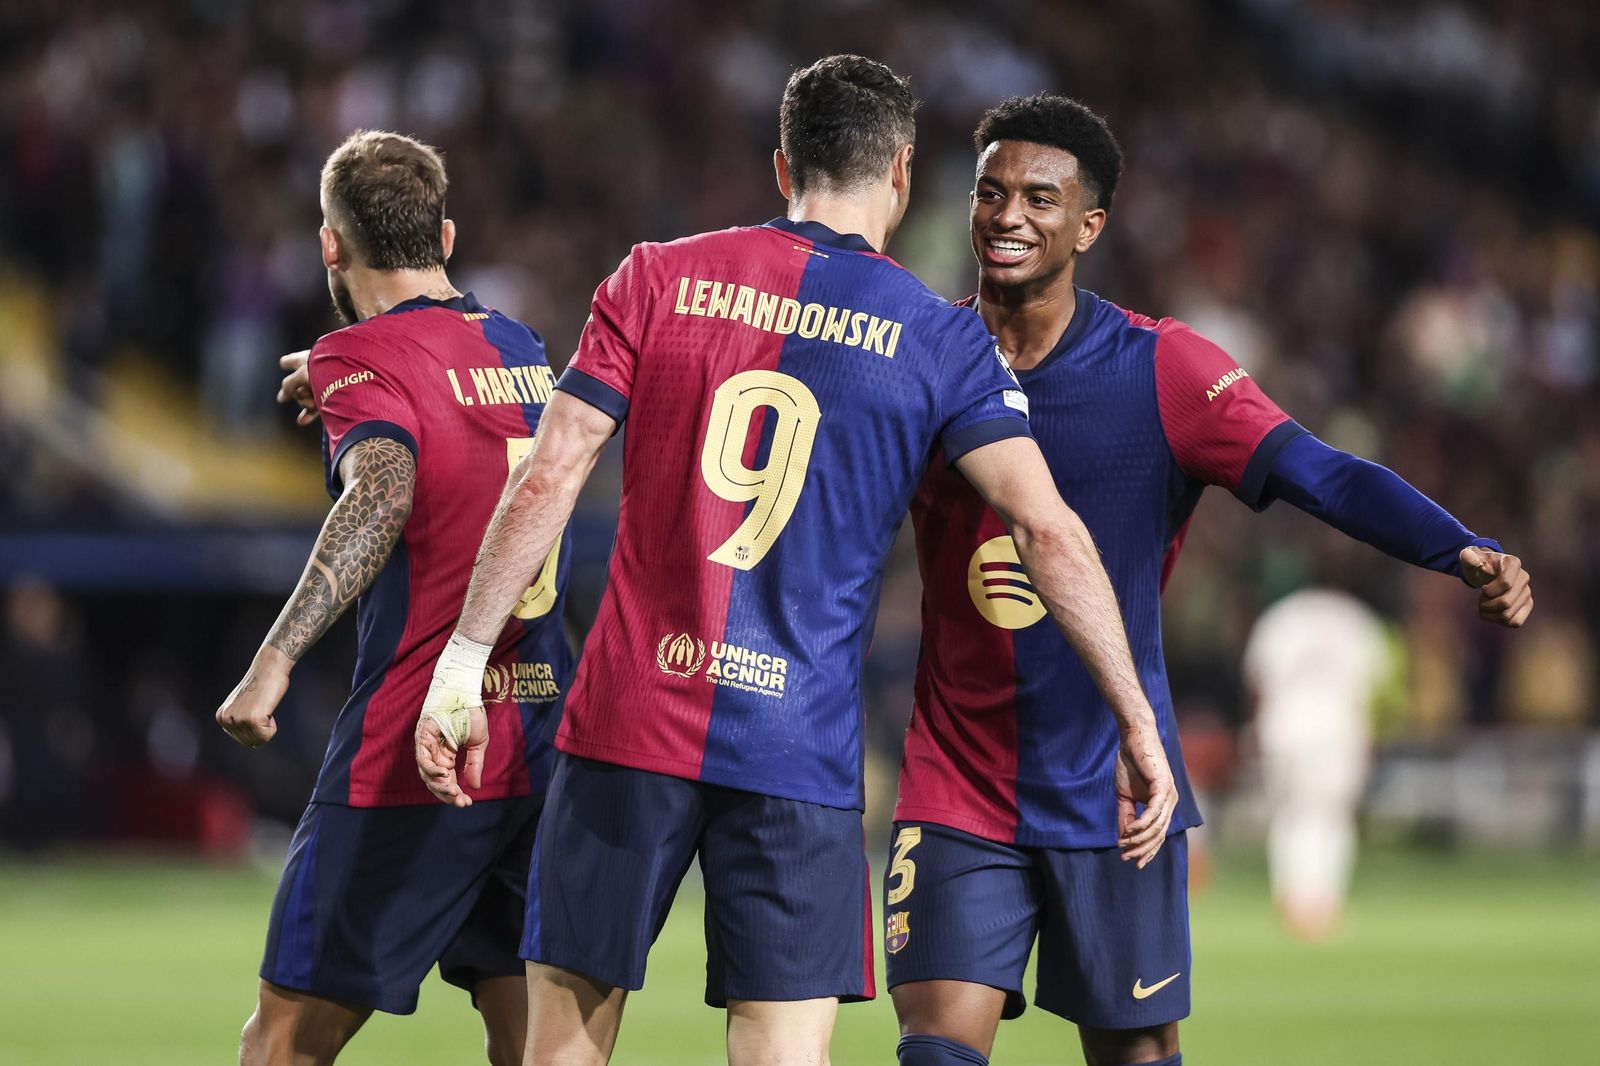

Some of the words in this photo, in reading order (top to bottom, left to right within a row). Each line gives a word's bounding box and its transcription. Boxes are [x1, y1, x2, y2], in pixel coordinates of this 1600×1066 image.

[674, 276, 903, 359] LEWANDOWSKI
[701, 370, 822, 571] 9
[511, 662, 554, 679] UNHCR
[710, 641, 787, 674] UNHCR
[511, 680, 560, 696] ACNUR
[705, 675, 718, 684] The
[719, 678, 730, 687] UN
[730, 681, 759, 693] Refugee
[758, 687, 784, 699] Agency
[706, 660, 786, 691] ACNUR
[888, 826, 921, 905] 3
